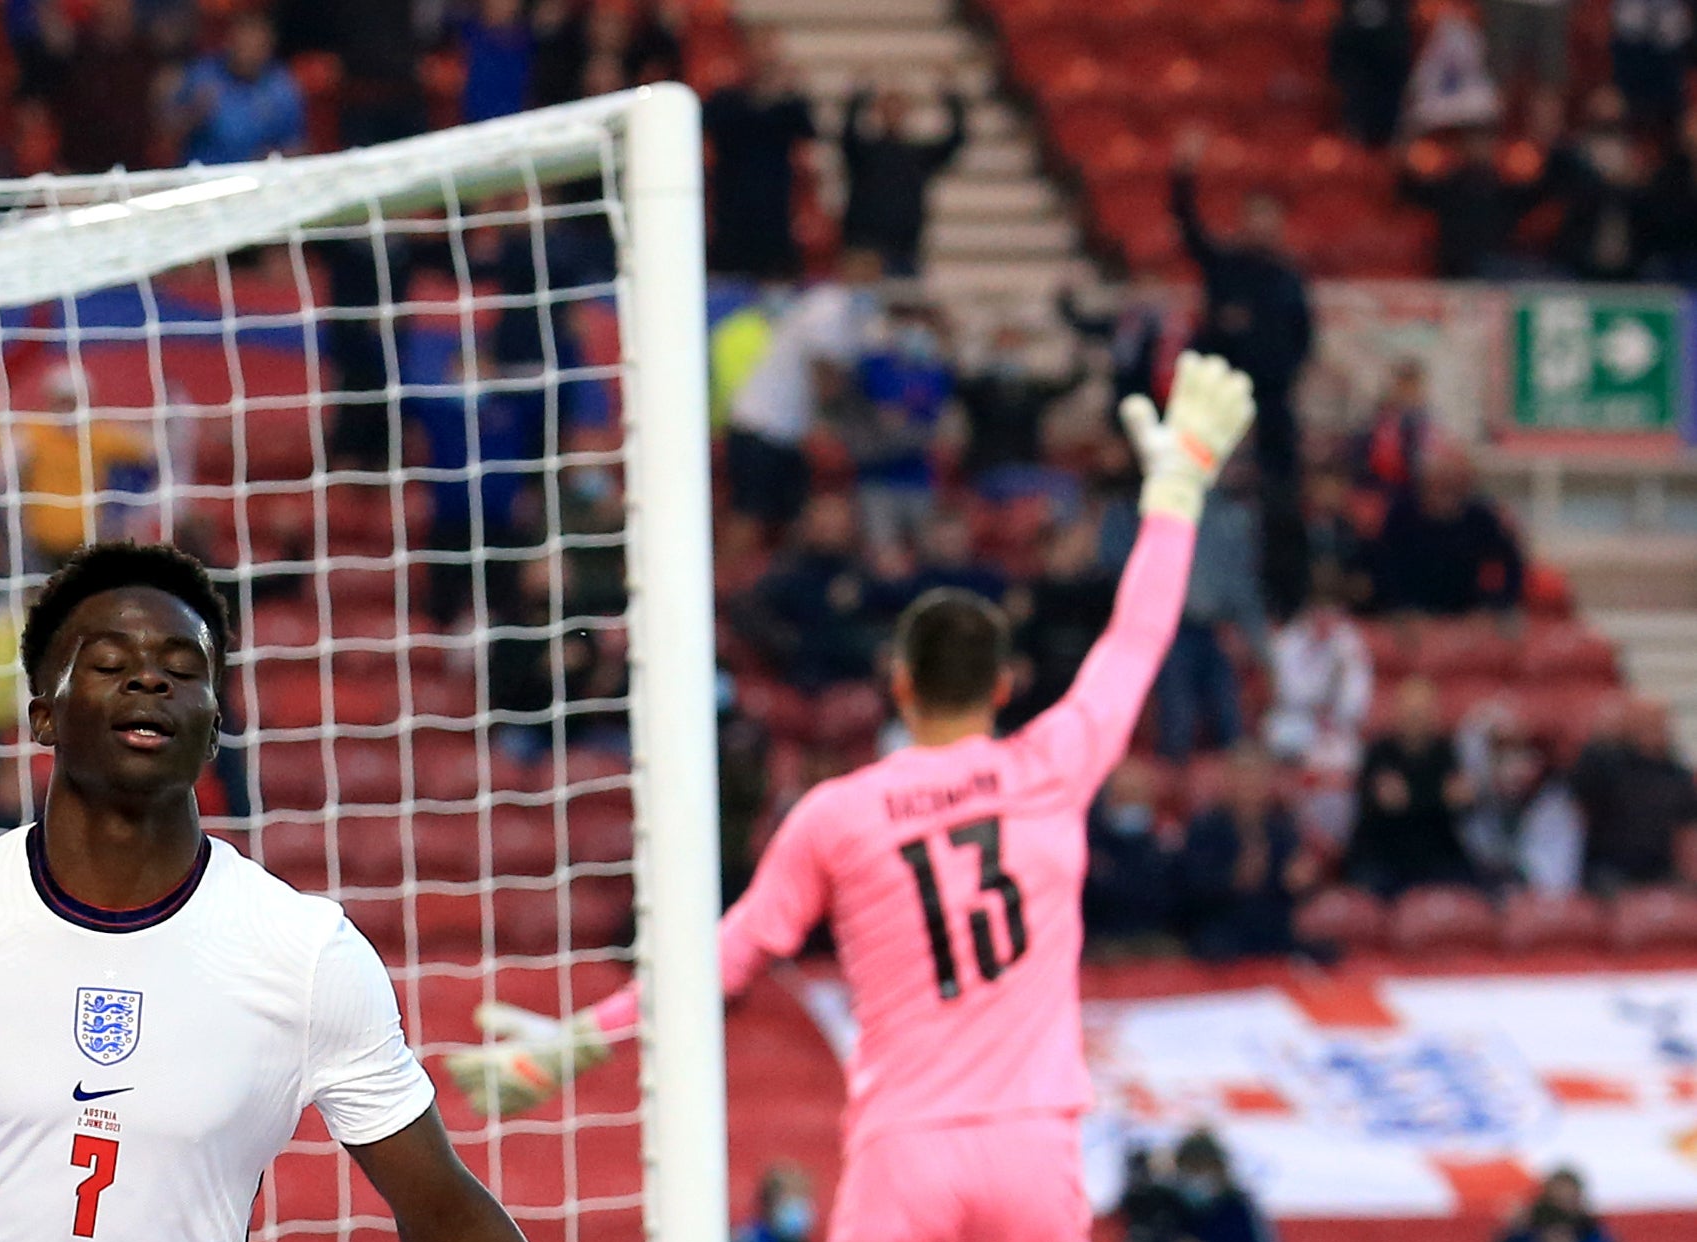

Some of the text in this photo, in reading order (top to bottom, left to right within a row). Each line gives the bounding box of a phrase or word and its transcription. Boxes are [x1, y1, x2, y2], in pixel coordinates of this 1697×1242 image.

[899, 815, 1028, 1000] 13
[83, 1107, 117, 1121] AUSTRIA
[84, 1118, 102, 1129] JUNE
[70, 1133, 120, 1239] 7
